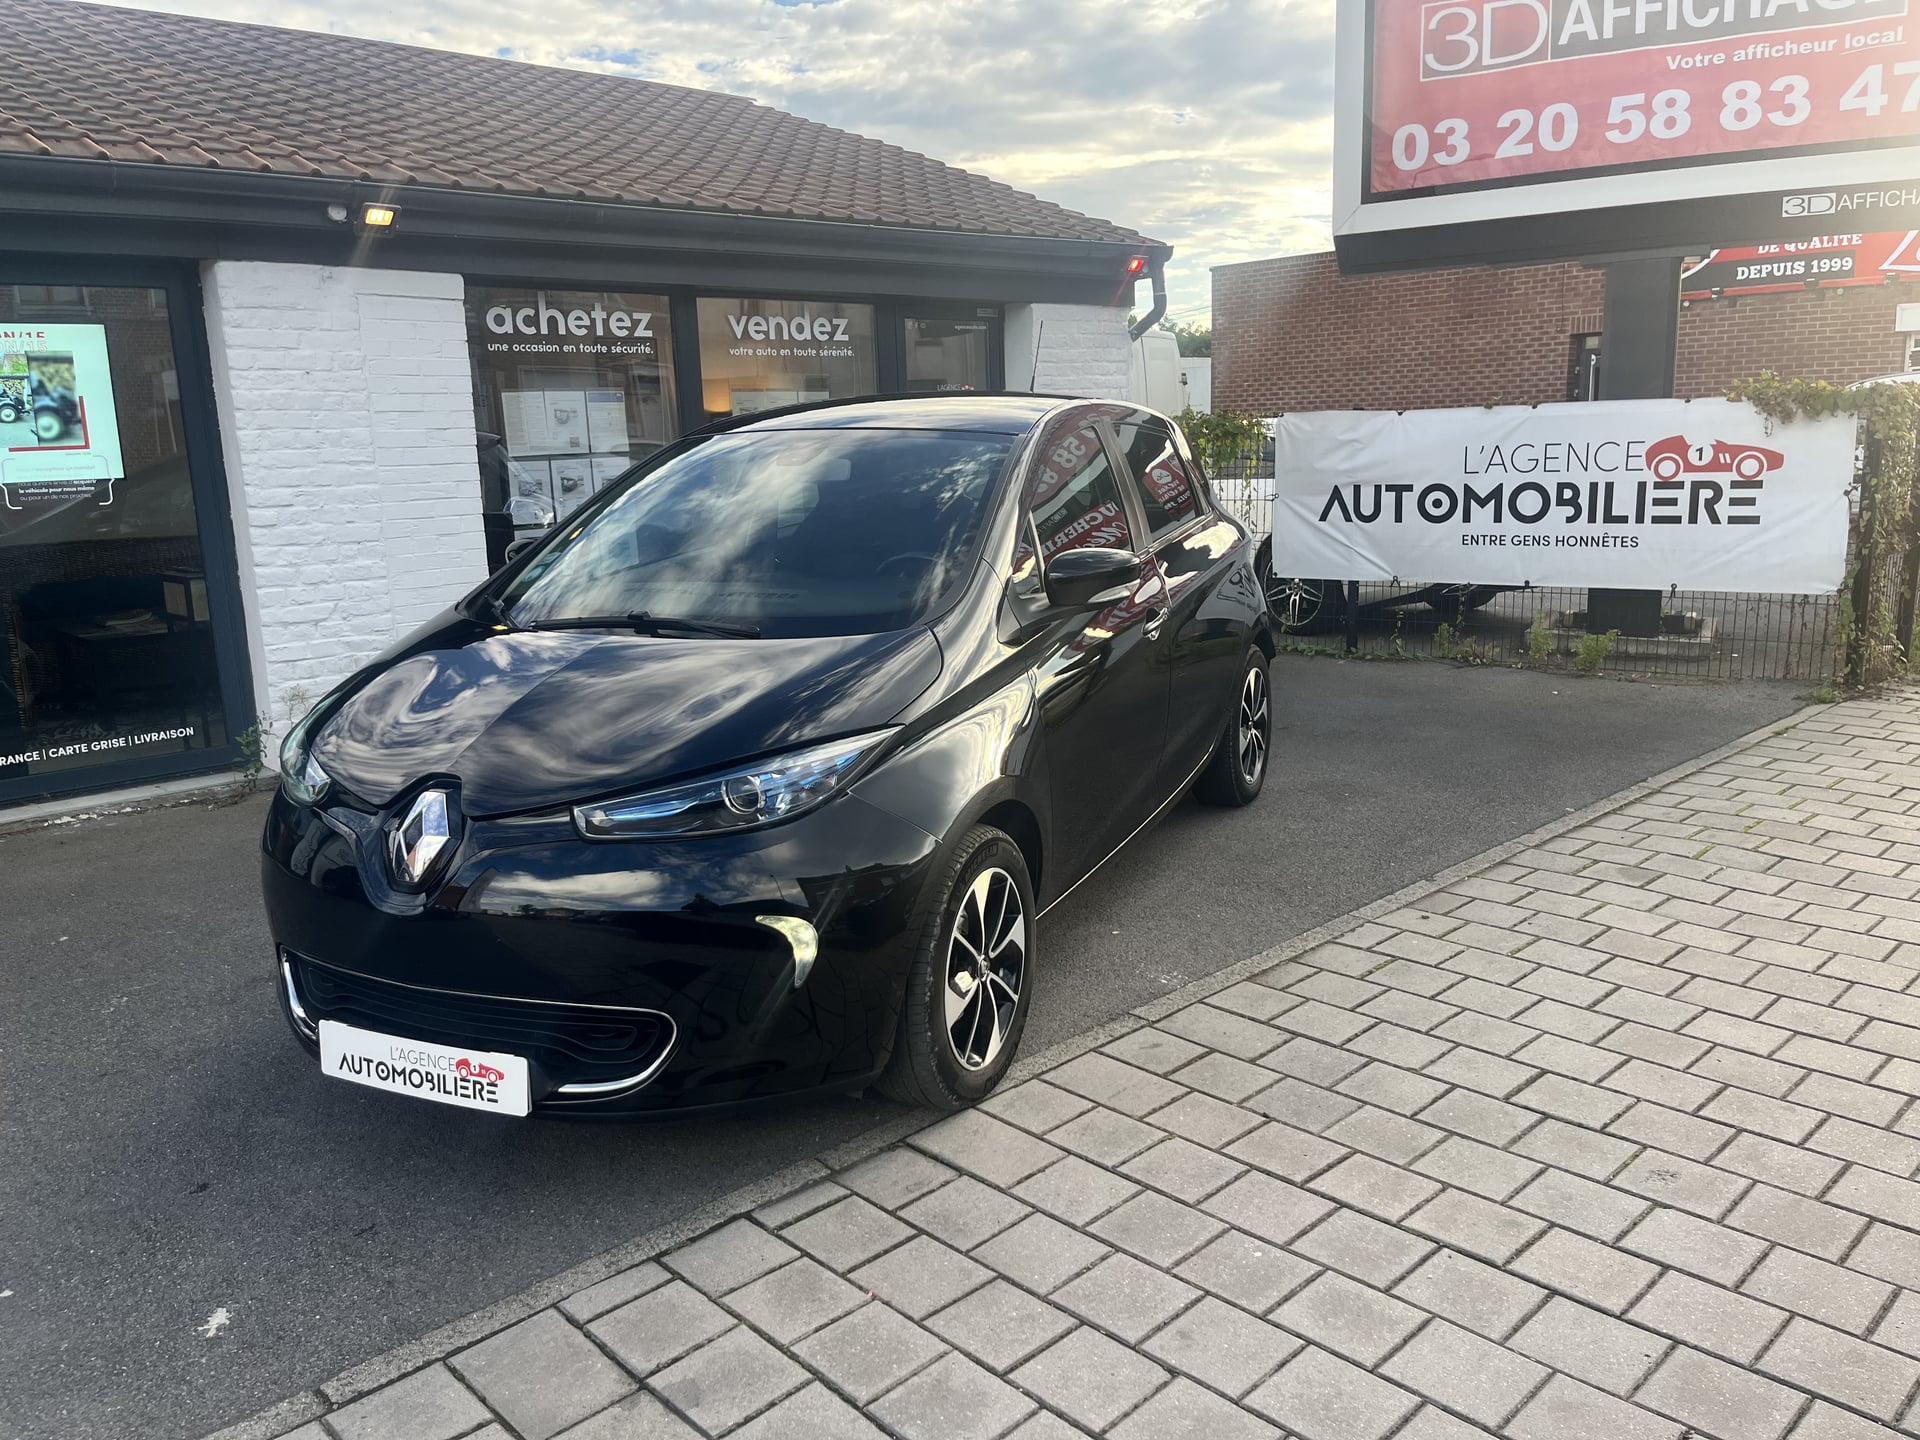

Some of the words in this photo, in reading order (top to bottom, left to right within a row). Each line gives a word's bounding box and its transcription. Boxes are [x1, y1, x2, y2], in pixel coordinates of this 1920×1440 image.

[1424, 0, 1548, 71] 3D
[1558, 0, 1880, 45] AFFIC
[1666, 51, 1726, 71] Votre
[1733, 39, 1838, 62] afficheur
[1844, 25, 1904, 49] local
[1392, 118, 1470, 170] 03
[1495, 103, 1578, 159] 20
[1605, 89, 1691, 143] 58
[1720, 75, 1811, 131] 83
[1840, 61, 1920, 116] 47
[1783, 194, 1835, 216] 3D
[1837, 188, 1920, 211] AFFICH
[1737, 261, 1805, 280] DEPUIS
[1811, 257, 1853, 273] 1999
[486, 291, 653, 338] achetez
[728, 303, 849, 341] vendez
[487, 343, 509, 352] une
[512, 341, 559, 353] occasion
[563, 345, 576, 353] en
[579, 342, 608, 354] toute
[611, 342, 654, 354] sécurité.
[729, 347, 753, 356] votre
[756, 347, 777, 356] auto
[780, 348, 790, 356] en
[794, 347, 817, 356] toute
[1463, 440, 1646, 475] L'AGENCE
[1462, 534, 1506, 546] ENTRE
[1511, 534, 1551, 547] GENS
[1555, 532, 1639, 548] HONNÊTES
[49, 743, 88, 758] CARTE
[91, 737, 126, 752] GRISE
[134, 727, 194, 745] LIVRAISON
[390, 1046, 456, 1072] L'AGENCE
